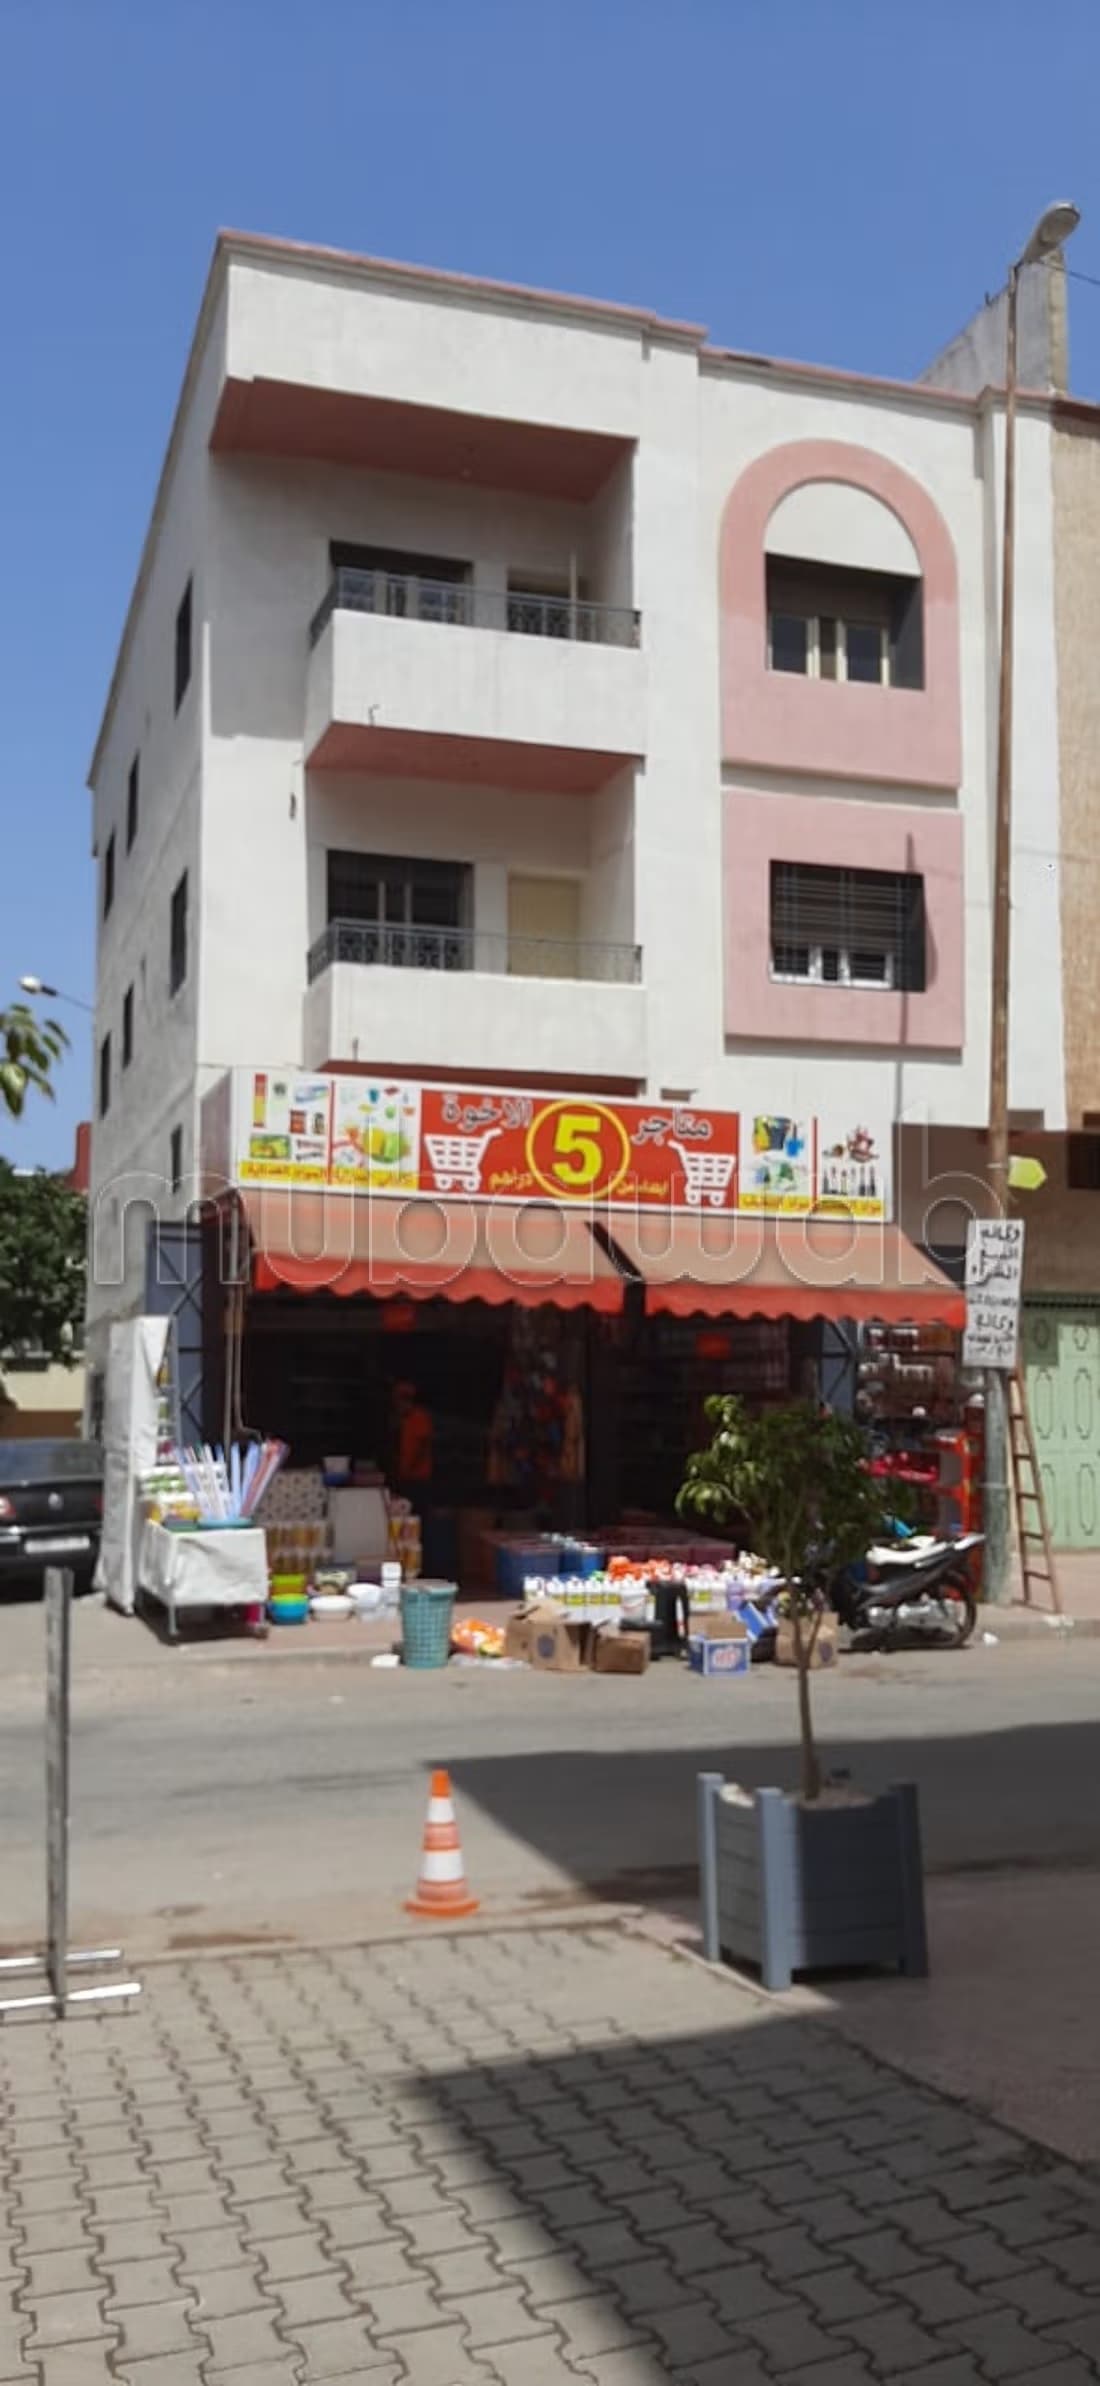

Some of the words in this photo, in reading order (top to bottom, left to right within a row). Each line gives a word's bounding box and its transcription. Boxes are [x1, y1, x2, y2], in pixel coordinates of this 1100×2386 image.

[442, 1094, 533, 1132] الاخوة
[631, 1105, 711, 1144] متاجر
[551, 1114, 602, 1186] 5
